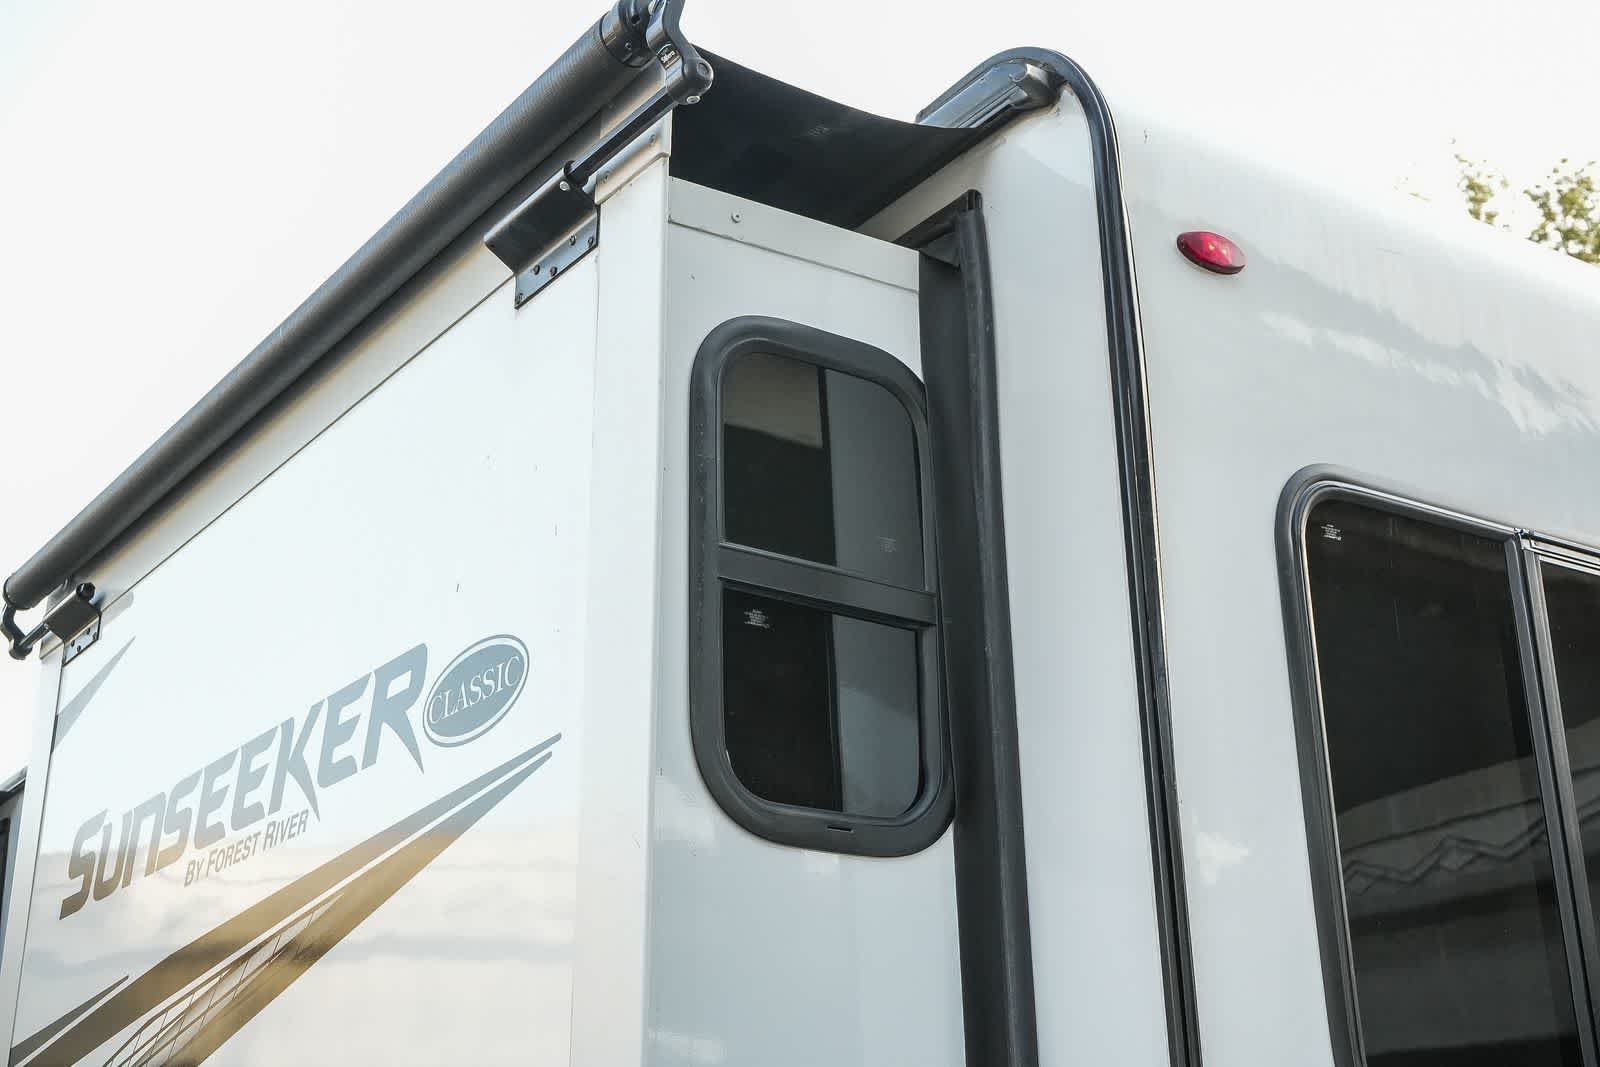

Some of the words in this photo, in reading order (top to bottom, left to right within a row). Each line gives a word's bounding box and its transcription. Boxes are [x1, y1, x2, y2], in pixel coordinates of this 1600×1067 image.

[428, 656, 520, 724] CLASSIC
[184, 858, 205, 888] BY
[206, 832, 262, 878] FOREST
[263, 809, 309, 850] RIVER
